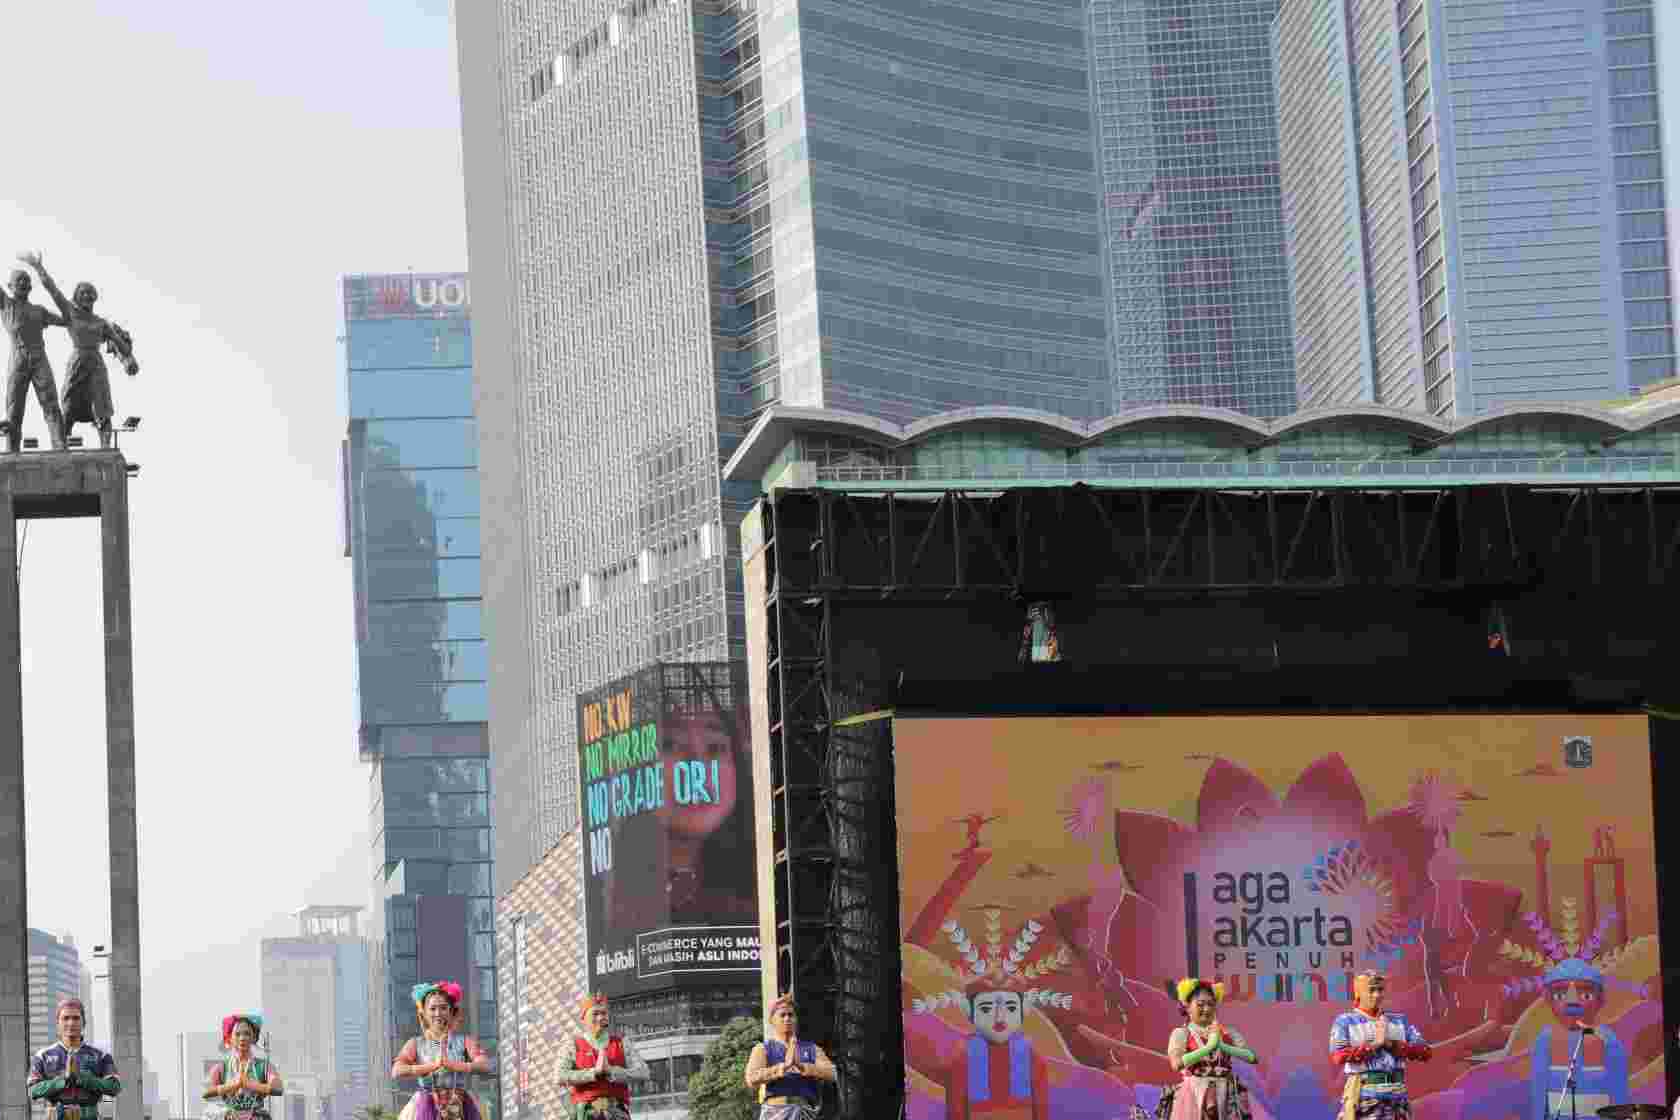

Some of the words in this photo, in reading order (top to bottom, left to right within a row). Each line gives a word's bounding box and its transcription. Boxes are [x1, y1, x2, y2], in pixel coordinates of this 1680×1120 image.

[416, 279, 470, 305] UO
[584, 702, 602, 743] NO
[584, 742, 602, 784] NO
[608, 723, 656, 773] MIRROR
[588, 780, 608, 832] NO
[611, 763, 665, 817] GRADE
[591, 828, 611, 876] NO
[697, 951, 724, 961] ASLI
[727, 950, 761, 961] INDO
[700, 937, 733, 949] YANG
[1214, 952, 1355, 969] PENUH
